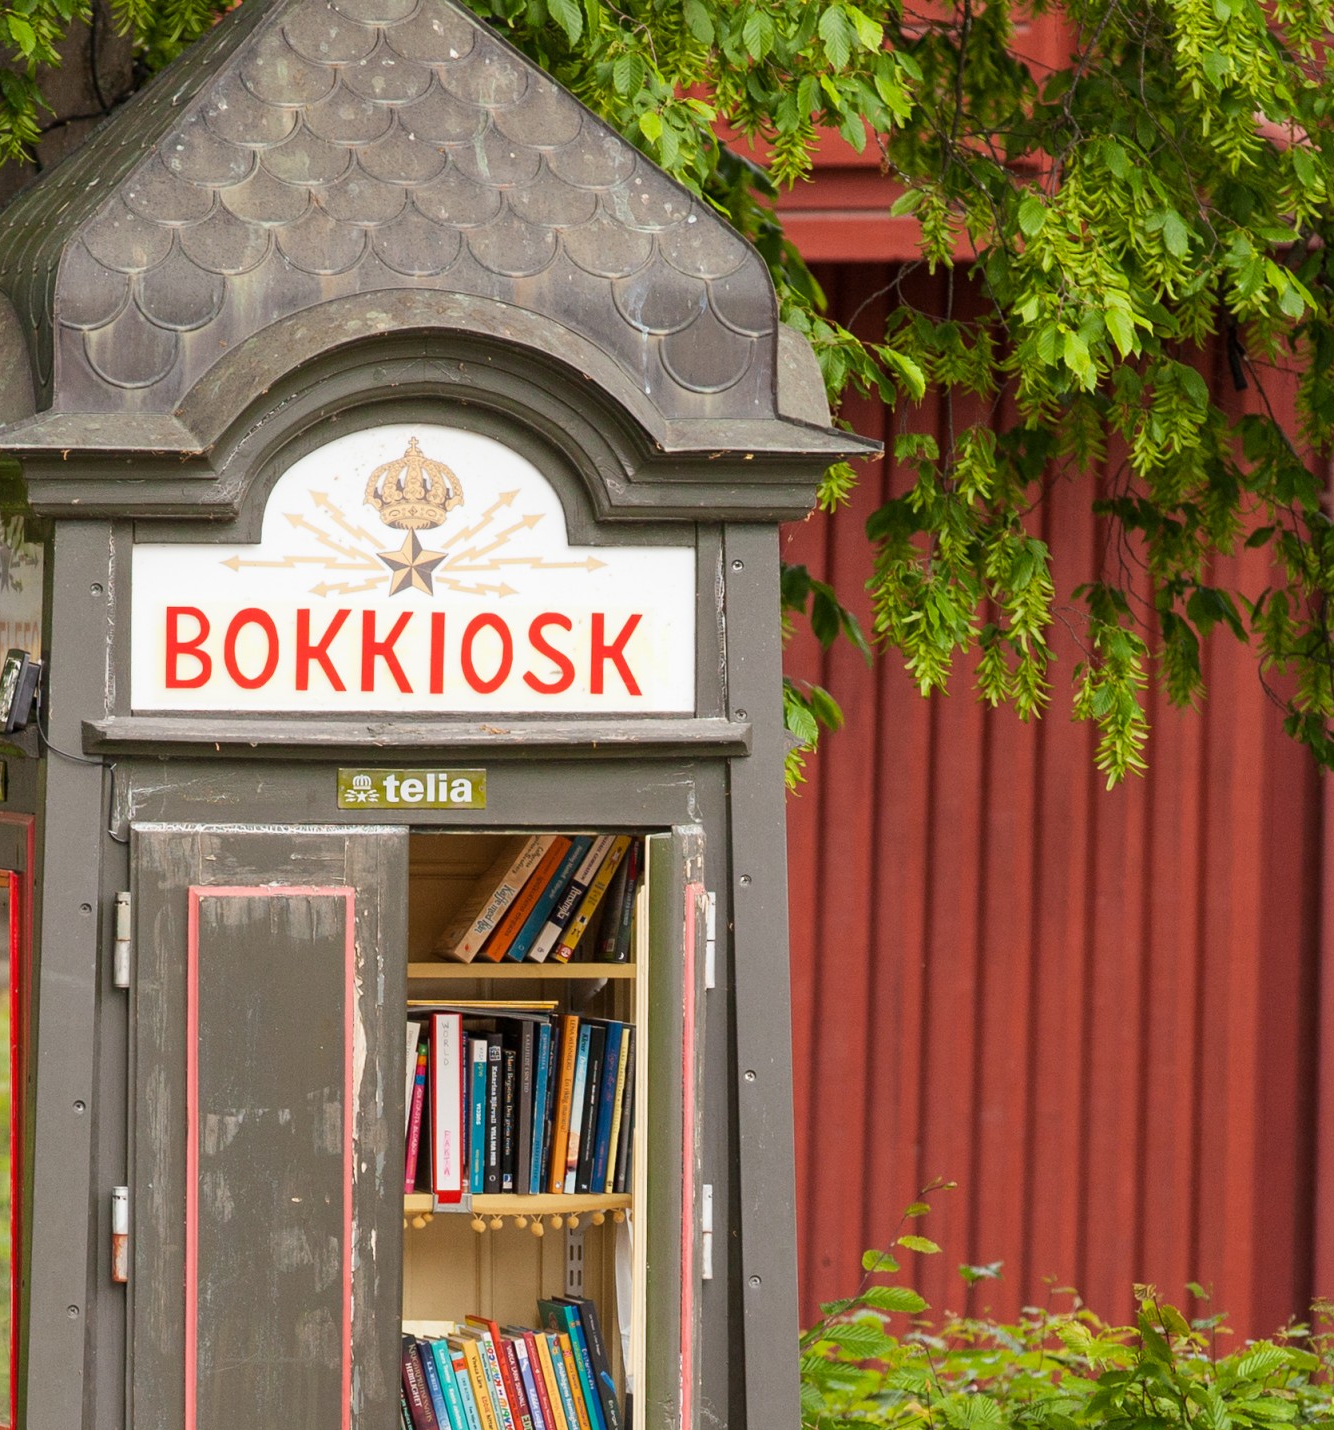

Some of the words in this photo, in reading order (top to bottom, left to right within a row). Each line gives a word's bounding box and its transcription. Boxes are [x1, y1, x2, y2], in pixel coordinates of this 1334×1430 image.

[164, 605, 643, 697] BOKKIOSK
[383, 769, 473, 804] telia
[493, 883, 514, 908] Kaffe
[484, 904, 500, 922] med
[442, 1022, 450, 1066] WORLD
[507, 1345, 515, 1365] VIVECA
[406, 1362, 422, 1408] HEMLIGHET
[471, 1356, 480, 1375] Viveca
[481, 1396, 490, 1414] EDDIE
[566, 1398, 578, 1430] hemlighet
[608, 1400, 614, 1408] En
